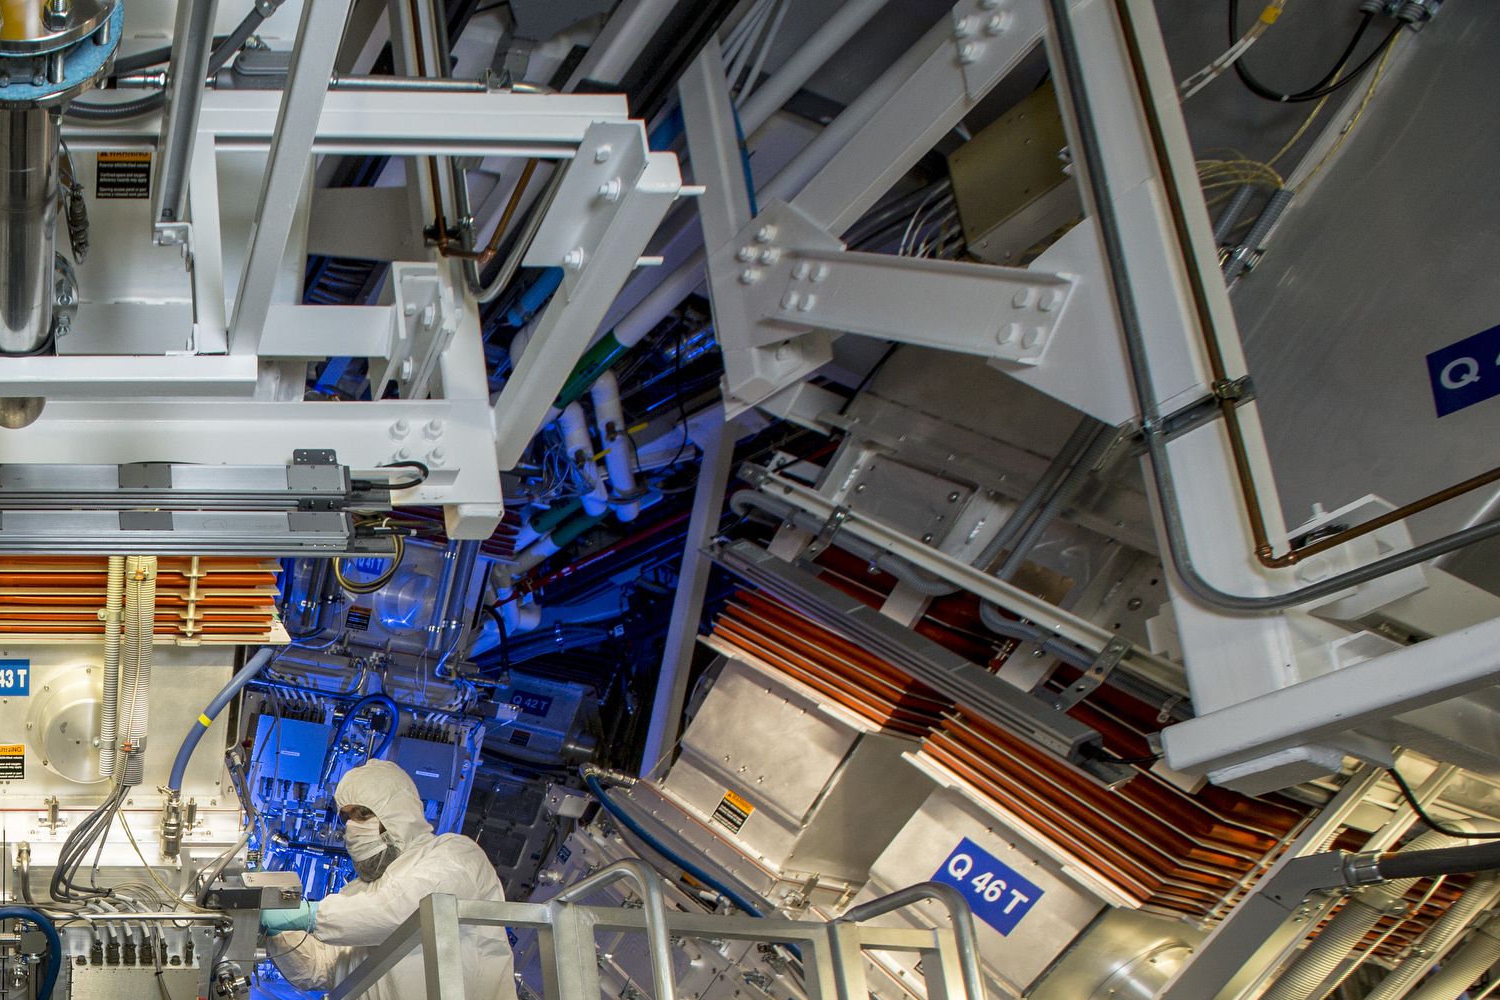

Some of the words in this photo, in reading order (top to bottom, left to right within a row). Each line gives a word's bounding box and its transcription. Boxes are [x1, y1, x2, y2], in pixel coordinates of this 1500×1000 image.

[1440, 356, 1480, 389] Q
[18, 669, 26, 688] T
[512, 694, 522, 705] Q
[524, 698, 537, 710] 42
[540, 701, 549, 711] T
[948, 853, 973, 881] Q
[971, 872, 1007, 903] 46
[1003, 888, 1030, 915] T
